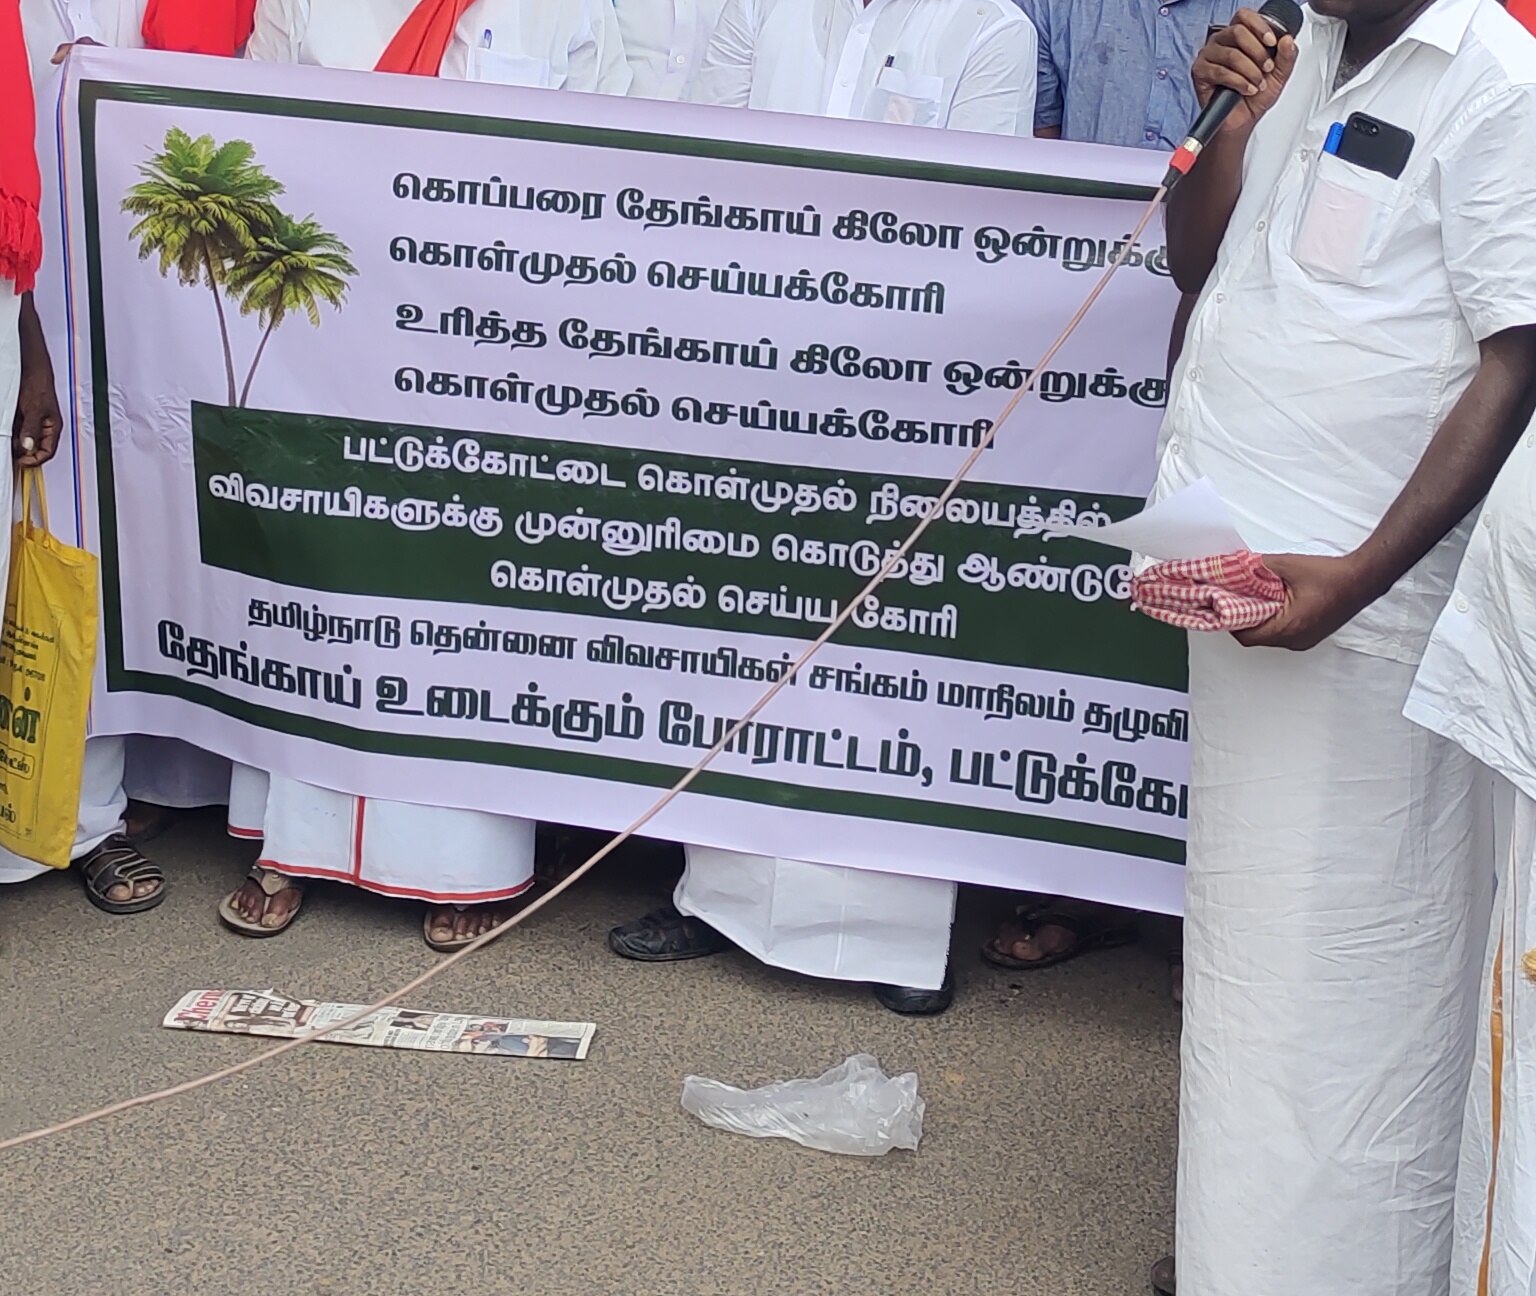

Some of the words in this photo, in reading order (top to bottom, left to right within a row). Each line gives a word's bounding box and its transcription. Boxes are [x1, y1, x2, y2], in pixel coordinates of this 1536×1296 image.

[393, 172, 606, 220] கொப்பரை
[616, 187, 821, 237] தேங்காய்
[832, 209, 963, 249] கிலோ
[389, 235, 636, 288] கொள்முதல்
[647, 260, 946, 315] செய்யக்கோரி
[395, 303, 547, 351] உரித்த
[559, 317, 777, 371] தேங்காய்
[790, 343, 932, 383] கிலோ
[943, 359, 1169, 409] ஒன்றுக்கு
[394, 366, 660, 420] கொள்முதல்
[671, 396, 995, 450] செய்யக்கோரி
[343, 435, 626, 489] பட்டுக்கோட்டை
[637, 462, 858, 515] கொள்முதல்
[208, 472, 503, 537] விவசாயிகளுக்கு
[514, 507, 758, 558] முன்னுரிமை
[771, 533, 944, 585] கொடுத்து
[490, 560, 707, 613] கொள்முதல்
[718, 583, 838, 623] செய்ய
[850, 594, 957, 639] கோரி
[158, 618, 362, 711] தேங்காய்
[375, 674, 645, 744] உடைக்கும்
[659, 700, 934, 787] போராட்டம்,
[248, 597, 401, 649] தமிழ்நாடு
[410, 618, 577, 661] தென்னை
[586, 633, 798, 685] விவசாயிகள்
[808, 661, 928, 703] சங்கம்
[937, 680, 1075, 724] மாநிலம்
